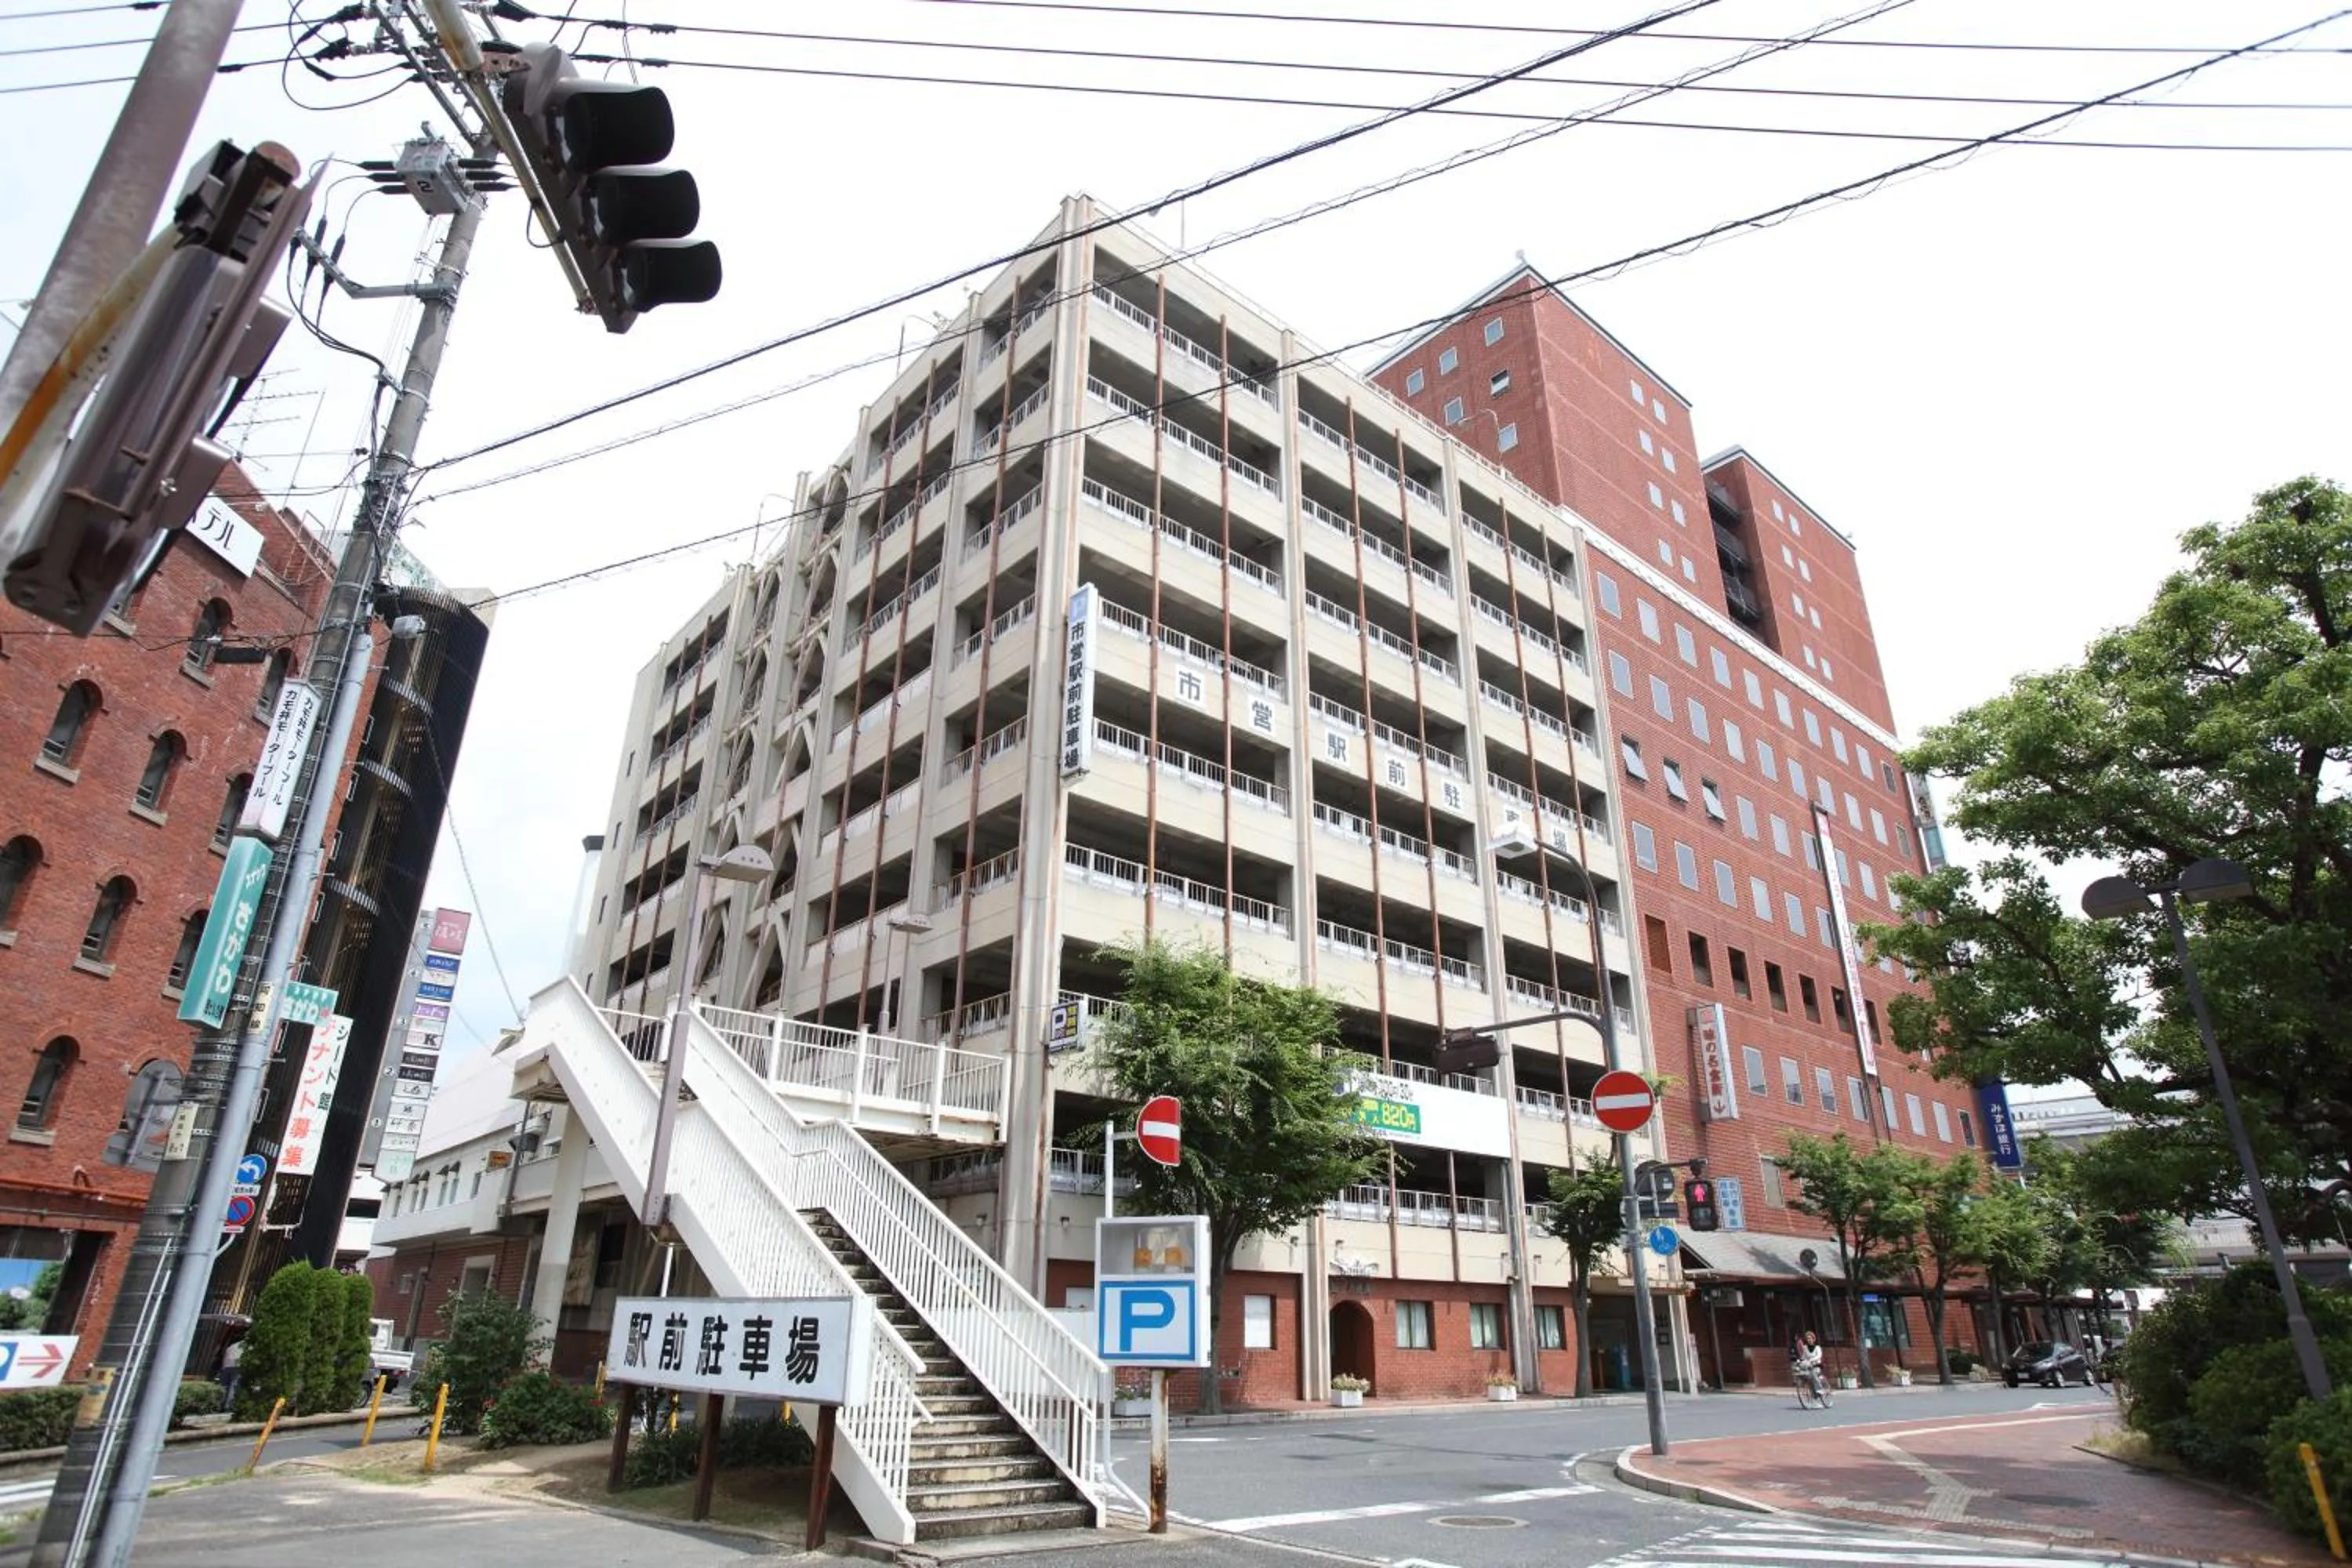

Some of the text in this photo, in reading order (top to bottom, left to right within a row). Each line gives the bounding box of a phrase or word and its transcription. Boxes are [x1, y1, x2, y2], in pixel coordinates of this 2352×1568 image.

[192, 506, 234, 549] テル
[1065, 620, 1085, 770] 市営駅前駐車場
[282, 1019, 336, 1167] テナント募集
[1991, 1102, 2011, 1156] みずほ銀行
[624, 1311, 821, 1385] 駅前駐車場
[1119, 1290, 1175, 1352] P
